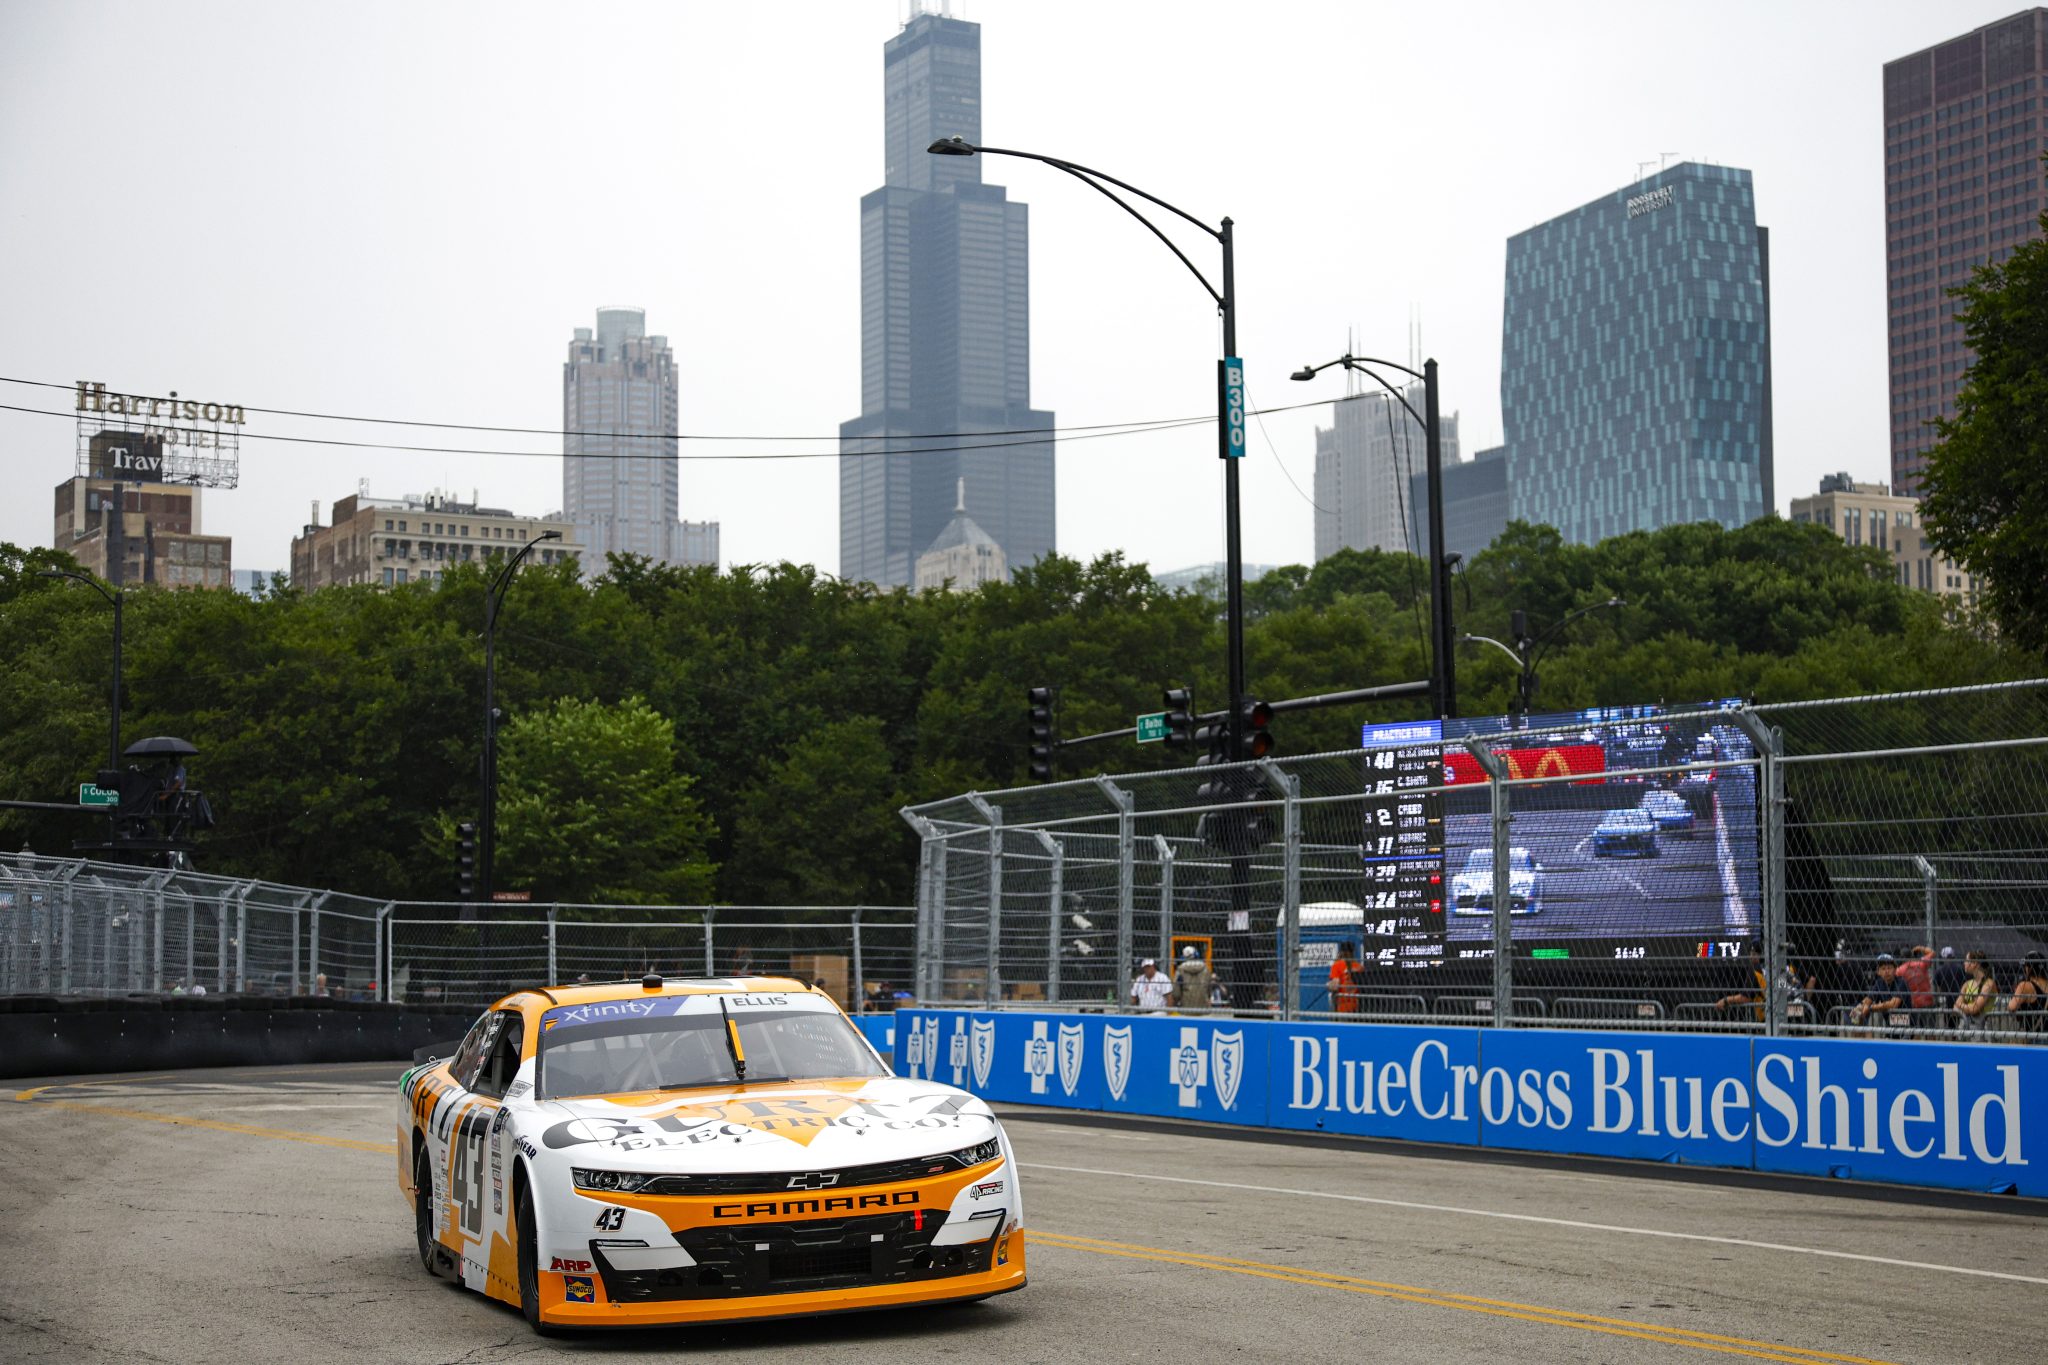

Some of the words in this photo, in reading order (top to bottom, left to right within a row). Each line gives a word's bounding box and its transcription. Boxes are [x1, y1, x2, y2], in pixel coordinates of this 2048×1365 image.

[75, 381, 246, 425] Harrison
[1227, 366, 1244, 447] B300
[144, 424, 227, 448] HOTEL
[1376, 808, 1394, 826] 2
[1718, 942, 1740, 958] TV
[564, 1001, 658, 1023] xfinity
[732, 996, 789, 1007] ELLIS
[1287, 1035, 1574, 1131] BlueCross
[1586, 1047, 2030, 1166] BlueShield
[617, 1115, 871, 1152] ELECTRIC
[452, 1105, 494, 1235] 43
[713, 1190, 920, 1219] CAMARO
[595, 1208, 627, 1231] 43
[549, 1256, 592, 1272] ARP
